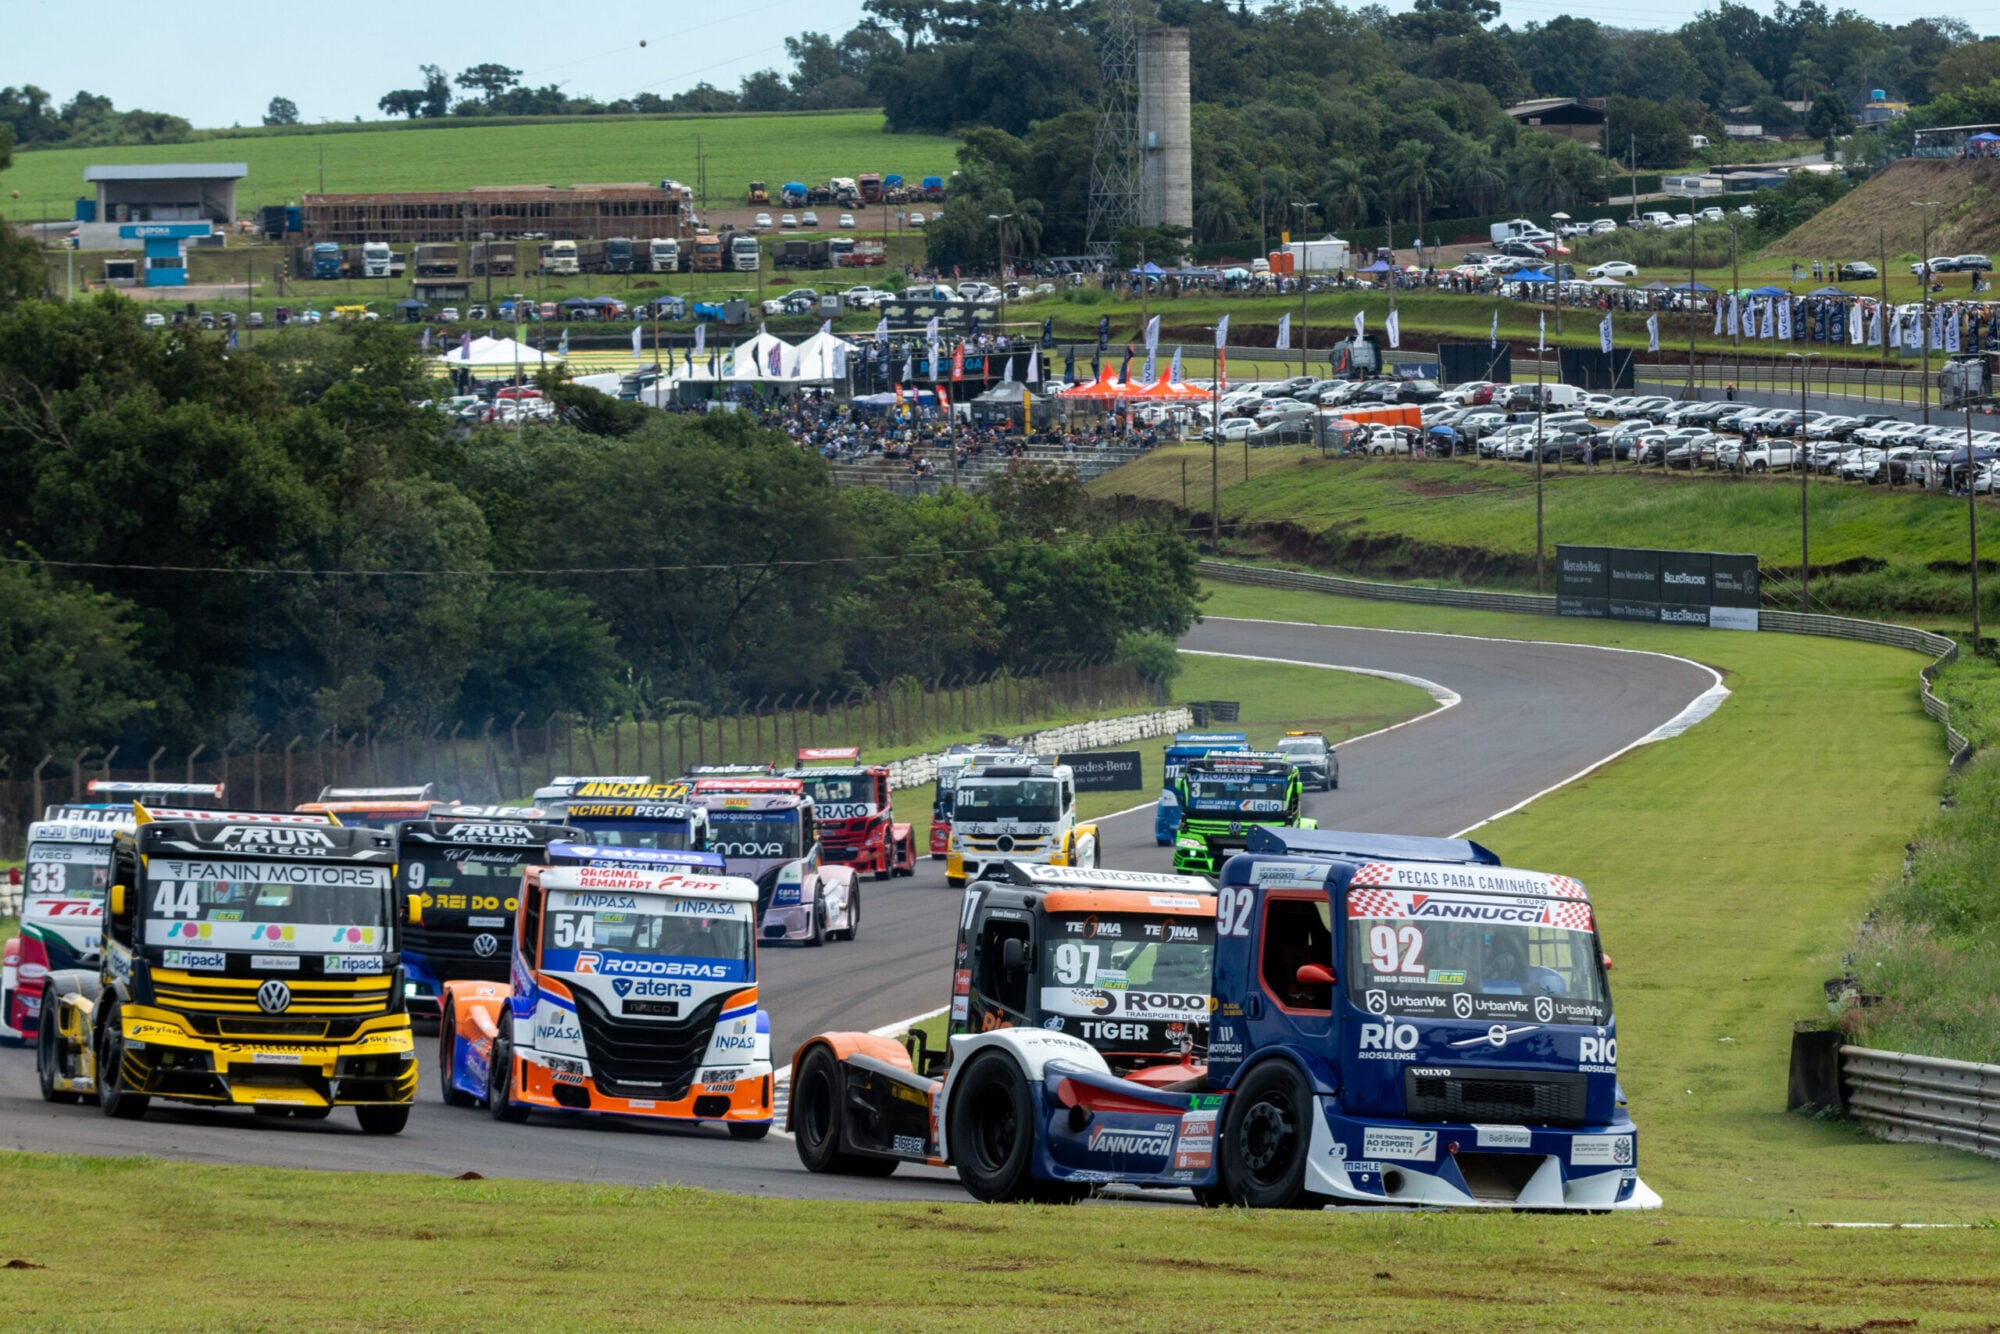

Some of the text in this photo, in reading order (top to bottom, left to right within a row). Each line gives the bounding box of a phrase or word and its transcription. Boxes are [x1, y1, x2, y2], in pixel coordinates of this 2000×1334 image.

[577, 782, 690, 799] ANCHIETA
[957, 790, 975, 806] 811
[1191, 782, 1201, 798] 3
[151, 809, 325, 824] PILOTO
[569, 805, 635, 817] NCHIETA
[814, 804, 868, 819] RRARO
[212, 825, 336, 848] FRUM
[446, 823, 535, 839] FRUM
[452, 836, 528, 845] METEOR
[224, 843, 327, 856] METEOR
[600, 848, 704, 863] atena
[30, 863, 66, 892] 33
[188, 864, 375, 886] FANIN MOTORS
[407, 862, 425, 890] 9
[580, 868, 639, 880] ORIGINAL
[1059, 868, 1191, 885] FRENOBRAS
[580, 878, 653, 890] REMAN FPT
[681, 880, 721, 891] FPT
[1398, 870, 1549, 895] PEÇAS PARA CAMINHÕES
[153, 881, 200, 918] 44
[436, 894, 467, 909] REI
[471, 896, 499, 910] DO
[581, 893, 636, 909] INPASA
[1516, 898, 1547, 906] GRUPO
[682, 901, 736, 915] INPASA
[1217, 887, 1254, 936] 92
[1407, 899, 1543, 923] VANNUCCI
[554, 913, 595, 949] 54
[1369, 924, 1426, 974] 92
[181, 952, 224, 968] ripack
[341, 954, 381, 972] ripack
[1056, 943, 1099, 985] 97
[605, 959, 727, 978] RODOBRAS
[1373, 975, 1398, 983] HUGO
[1439, 975, 1463, 983] ELITE
[634, 979, 692, 997] atena
[1124, 993, 1205, 1011] RODO
[1390, 996, 1447, 1008] UrbanVix
[1475, 1000, 1529, 1013] UrbanVix
[1125, 1011, 1180, 1020] TRANSPORTE
[1555, 1004, 1603, 1017] UrbanVix
[1080, 1021, 1150, 1041] TIGER
[1359, 1023, 1419, 1050] RIO
[1358, 1051, 1417, 1061] RIOSULENSE
[1579, 1036, 1617, 1064] RIO
[1411, 1068, 1451, 1077] VOLVO
[1154, 1123, 1176, 1132] GRUPO
[1088, 1127, 1175, 1156] VANNUCCI
[1381, 1140, 1414, 1148] ESPORTE
[1505, 1134, 1529, 1144] BeVant
[1344, 1162, 1380, 1171] MAHLE
